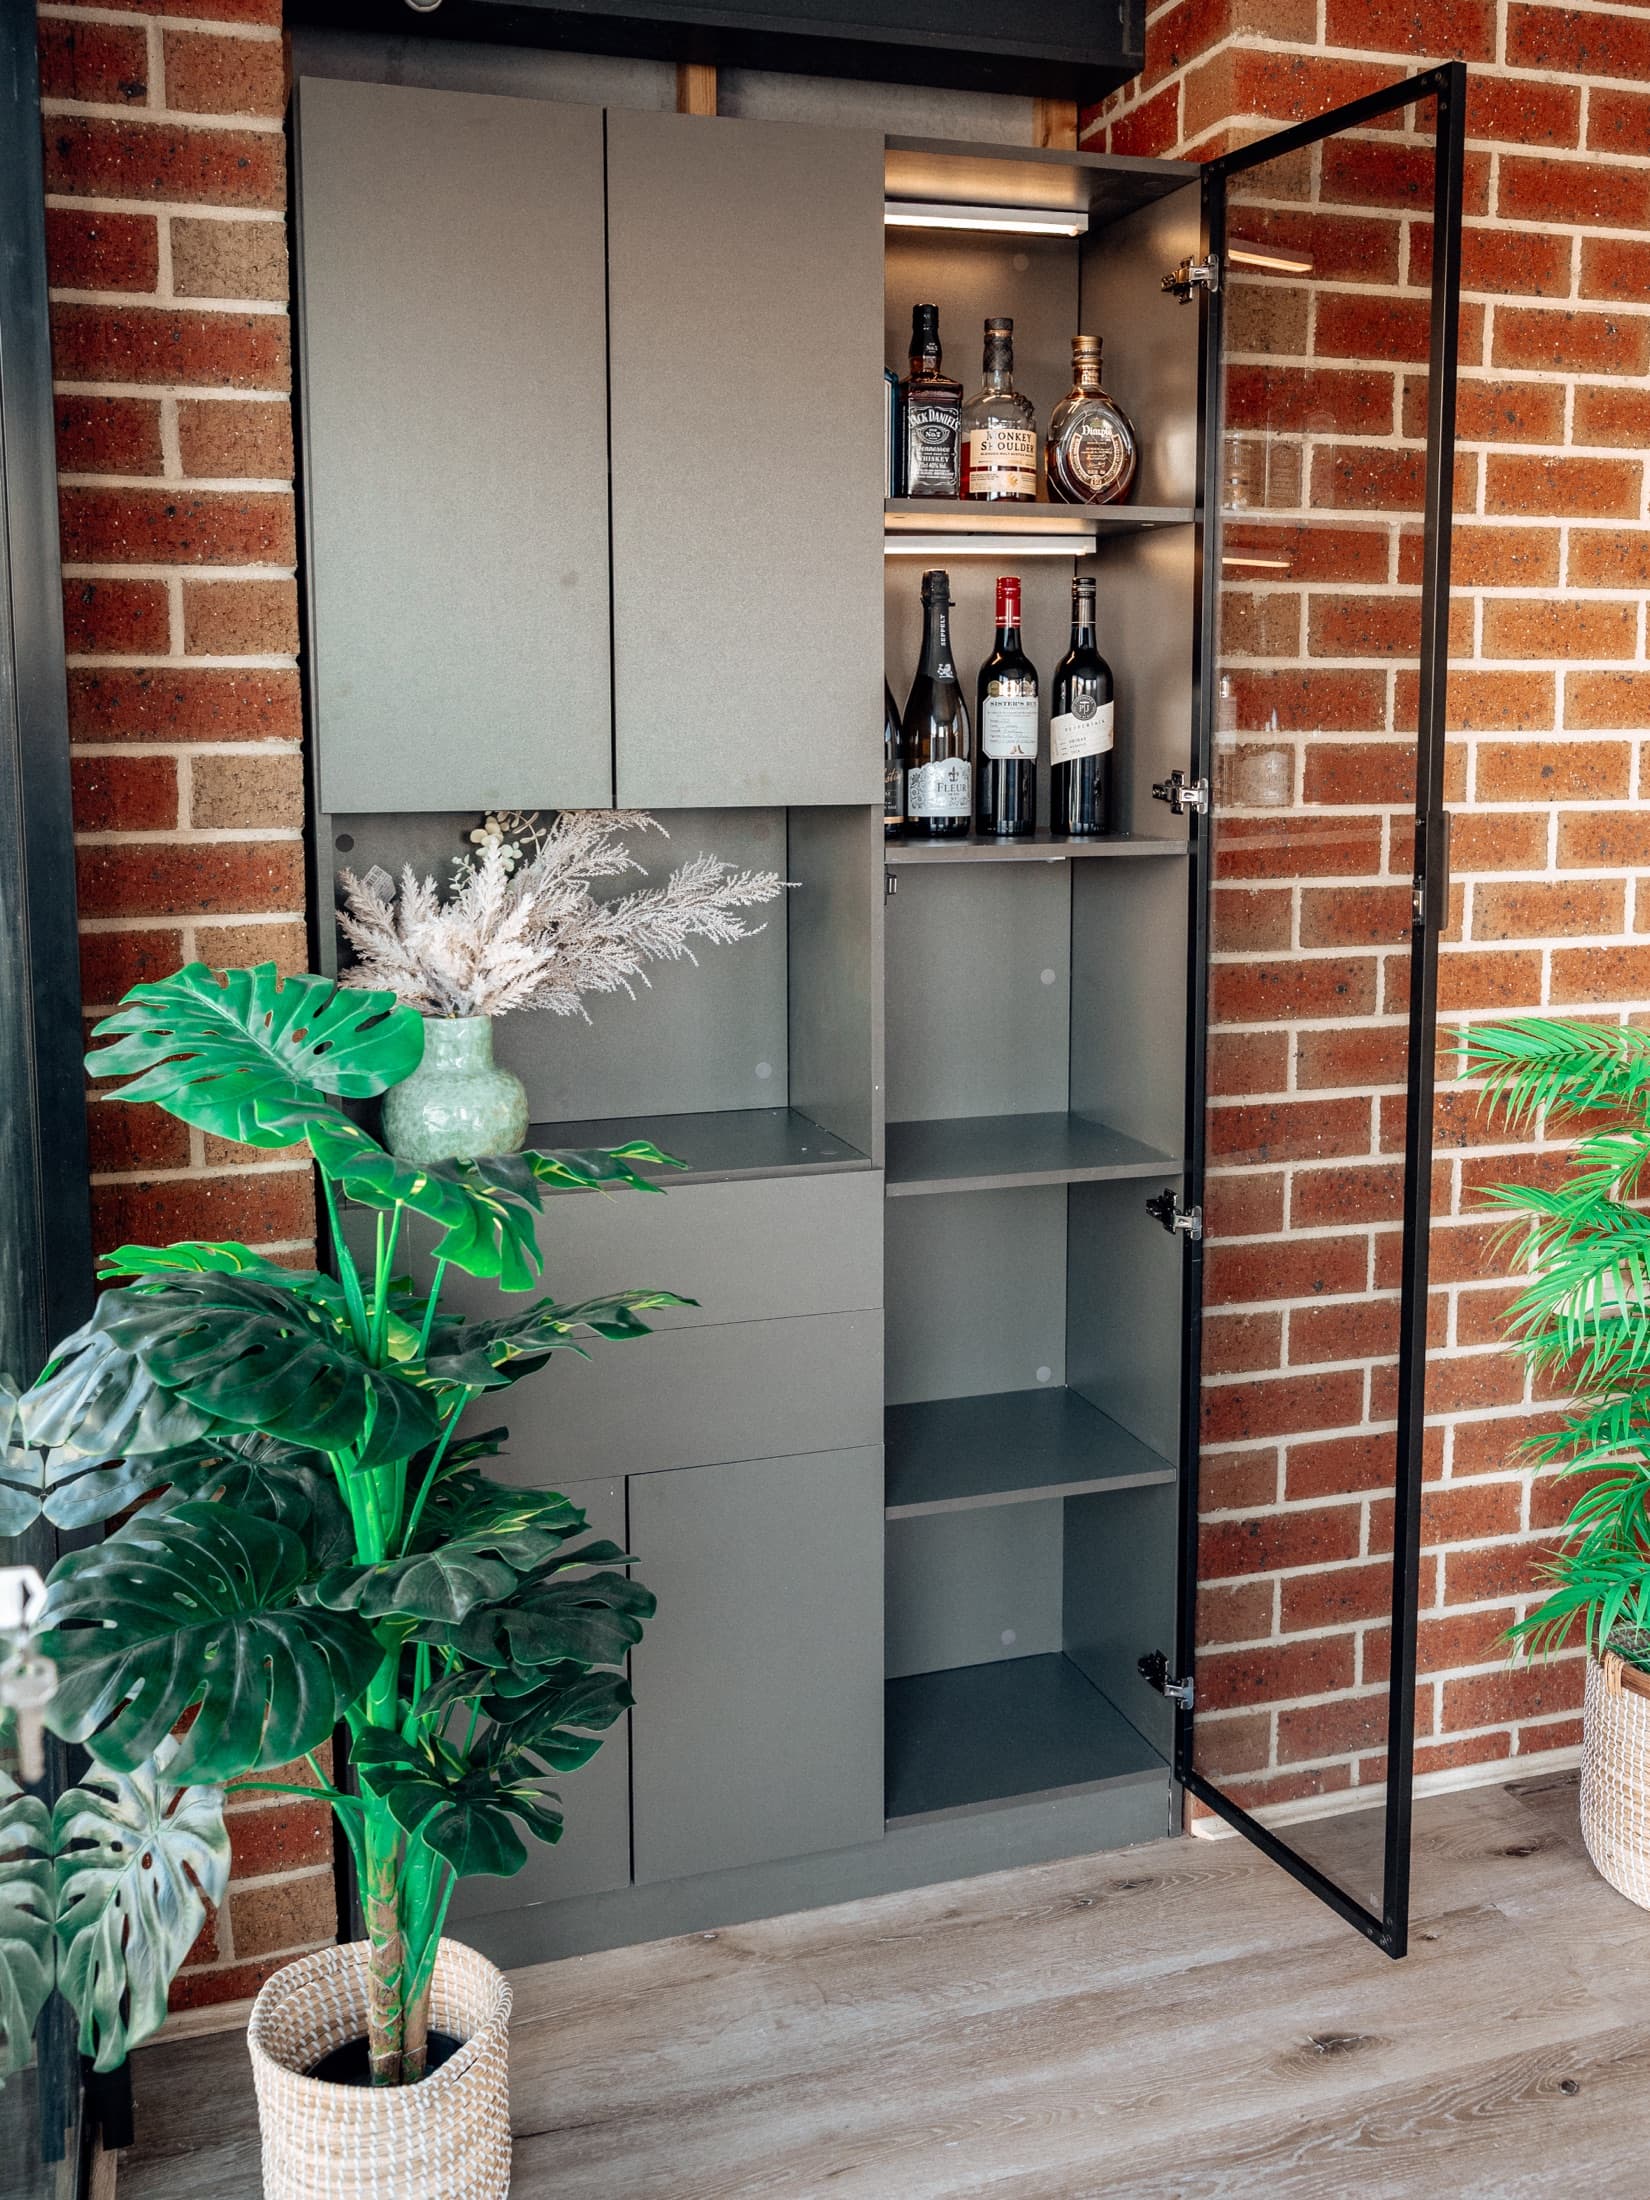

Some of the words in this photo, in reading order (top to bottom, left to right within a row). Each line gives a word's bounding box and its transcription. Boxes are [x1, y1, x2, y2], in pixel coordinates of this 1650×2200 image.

[908, 411, 928, 429] JACK
[928, 408, 961, 431] DANIEL'S
[937, 783, 967, 793] FLEUR
